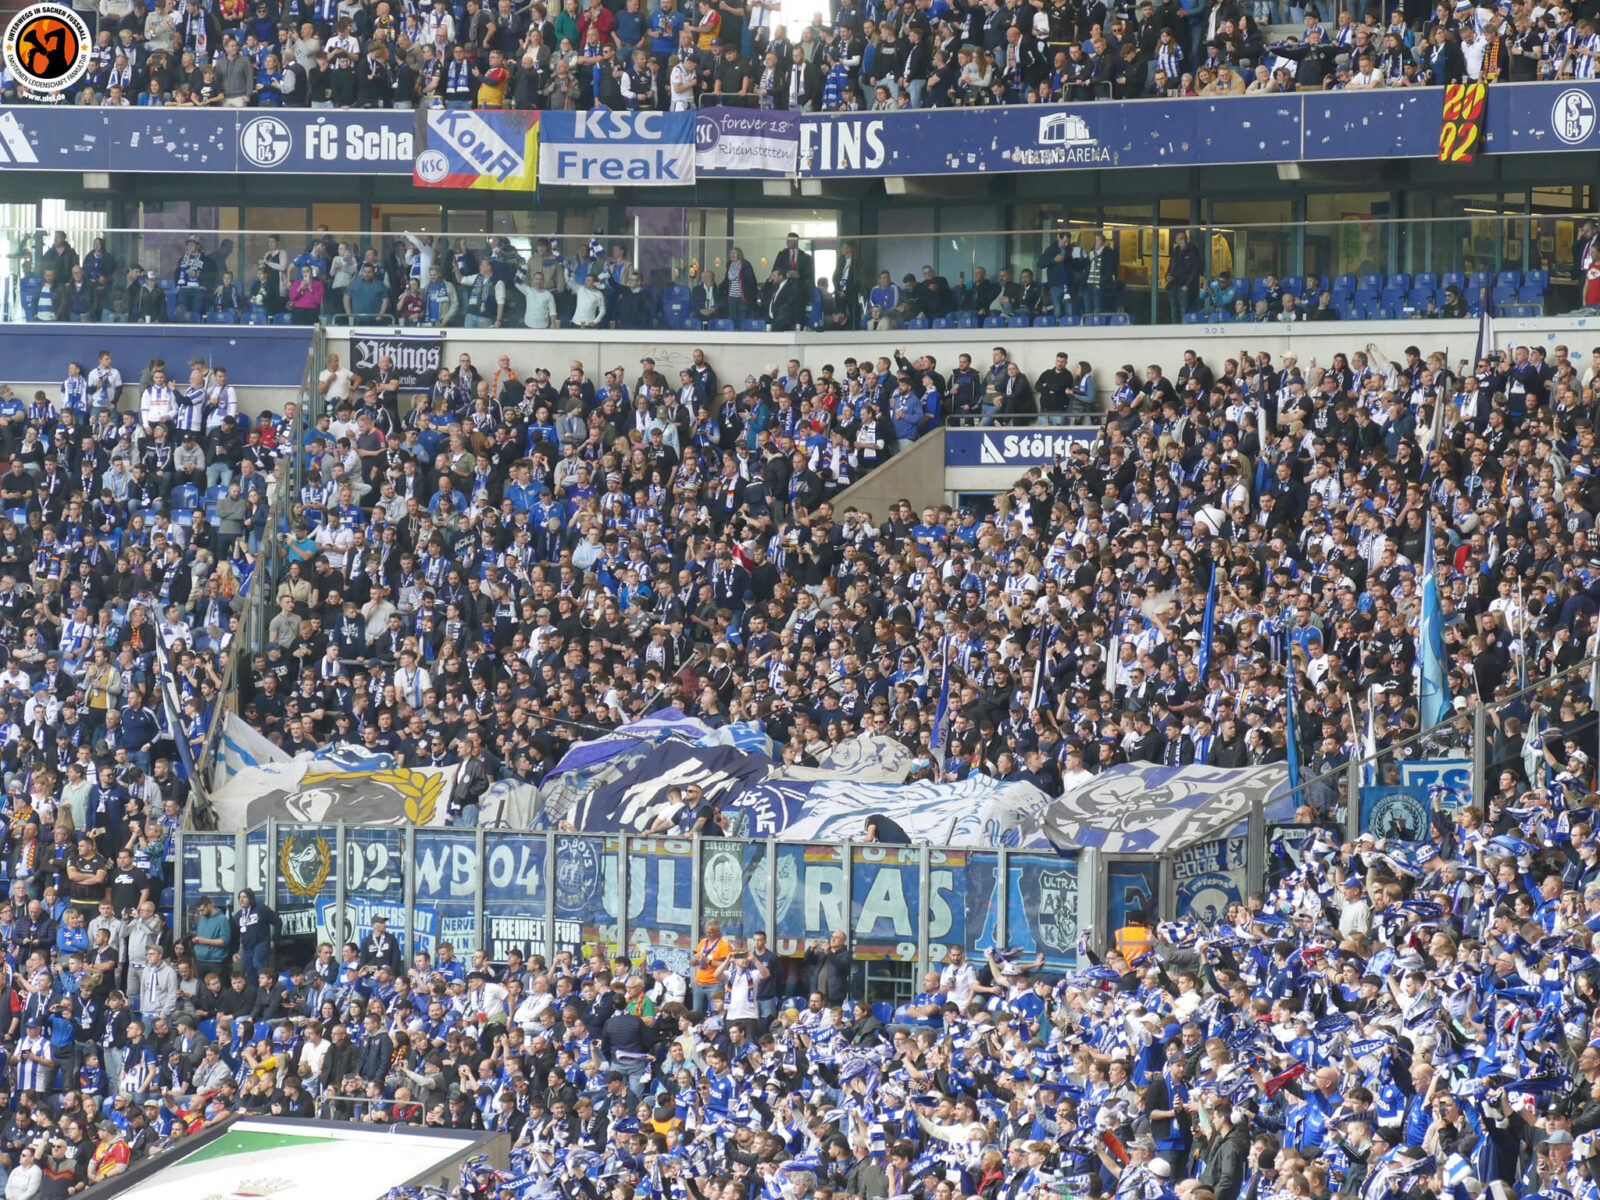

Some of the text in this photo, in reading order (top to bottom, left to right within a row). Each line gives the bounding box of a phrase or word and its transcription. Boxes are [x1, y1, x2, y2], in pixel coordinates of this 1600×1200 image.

[574, 110, 663, 139] KSC
[719, 114, 768, 132] forever
[305, 124, 338, 160] FC
[718, 144, 791, 160] Rheinstetten
[1067, 147, 1111, 162] ARENA
[421, 159, 444, 172] KSC
[557, 150, 680, 180] Freak
[355, 340, 441, 375] Vikings
[346, 842, 390, 892] 02
[555, 920, 581, 944] FÜR
